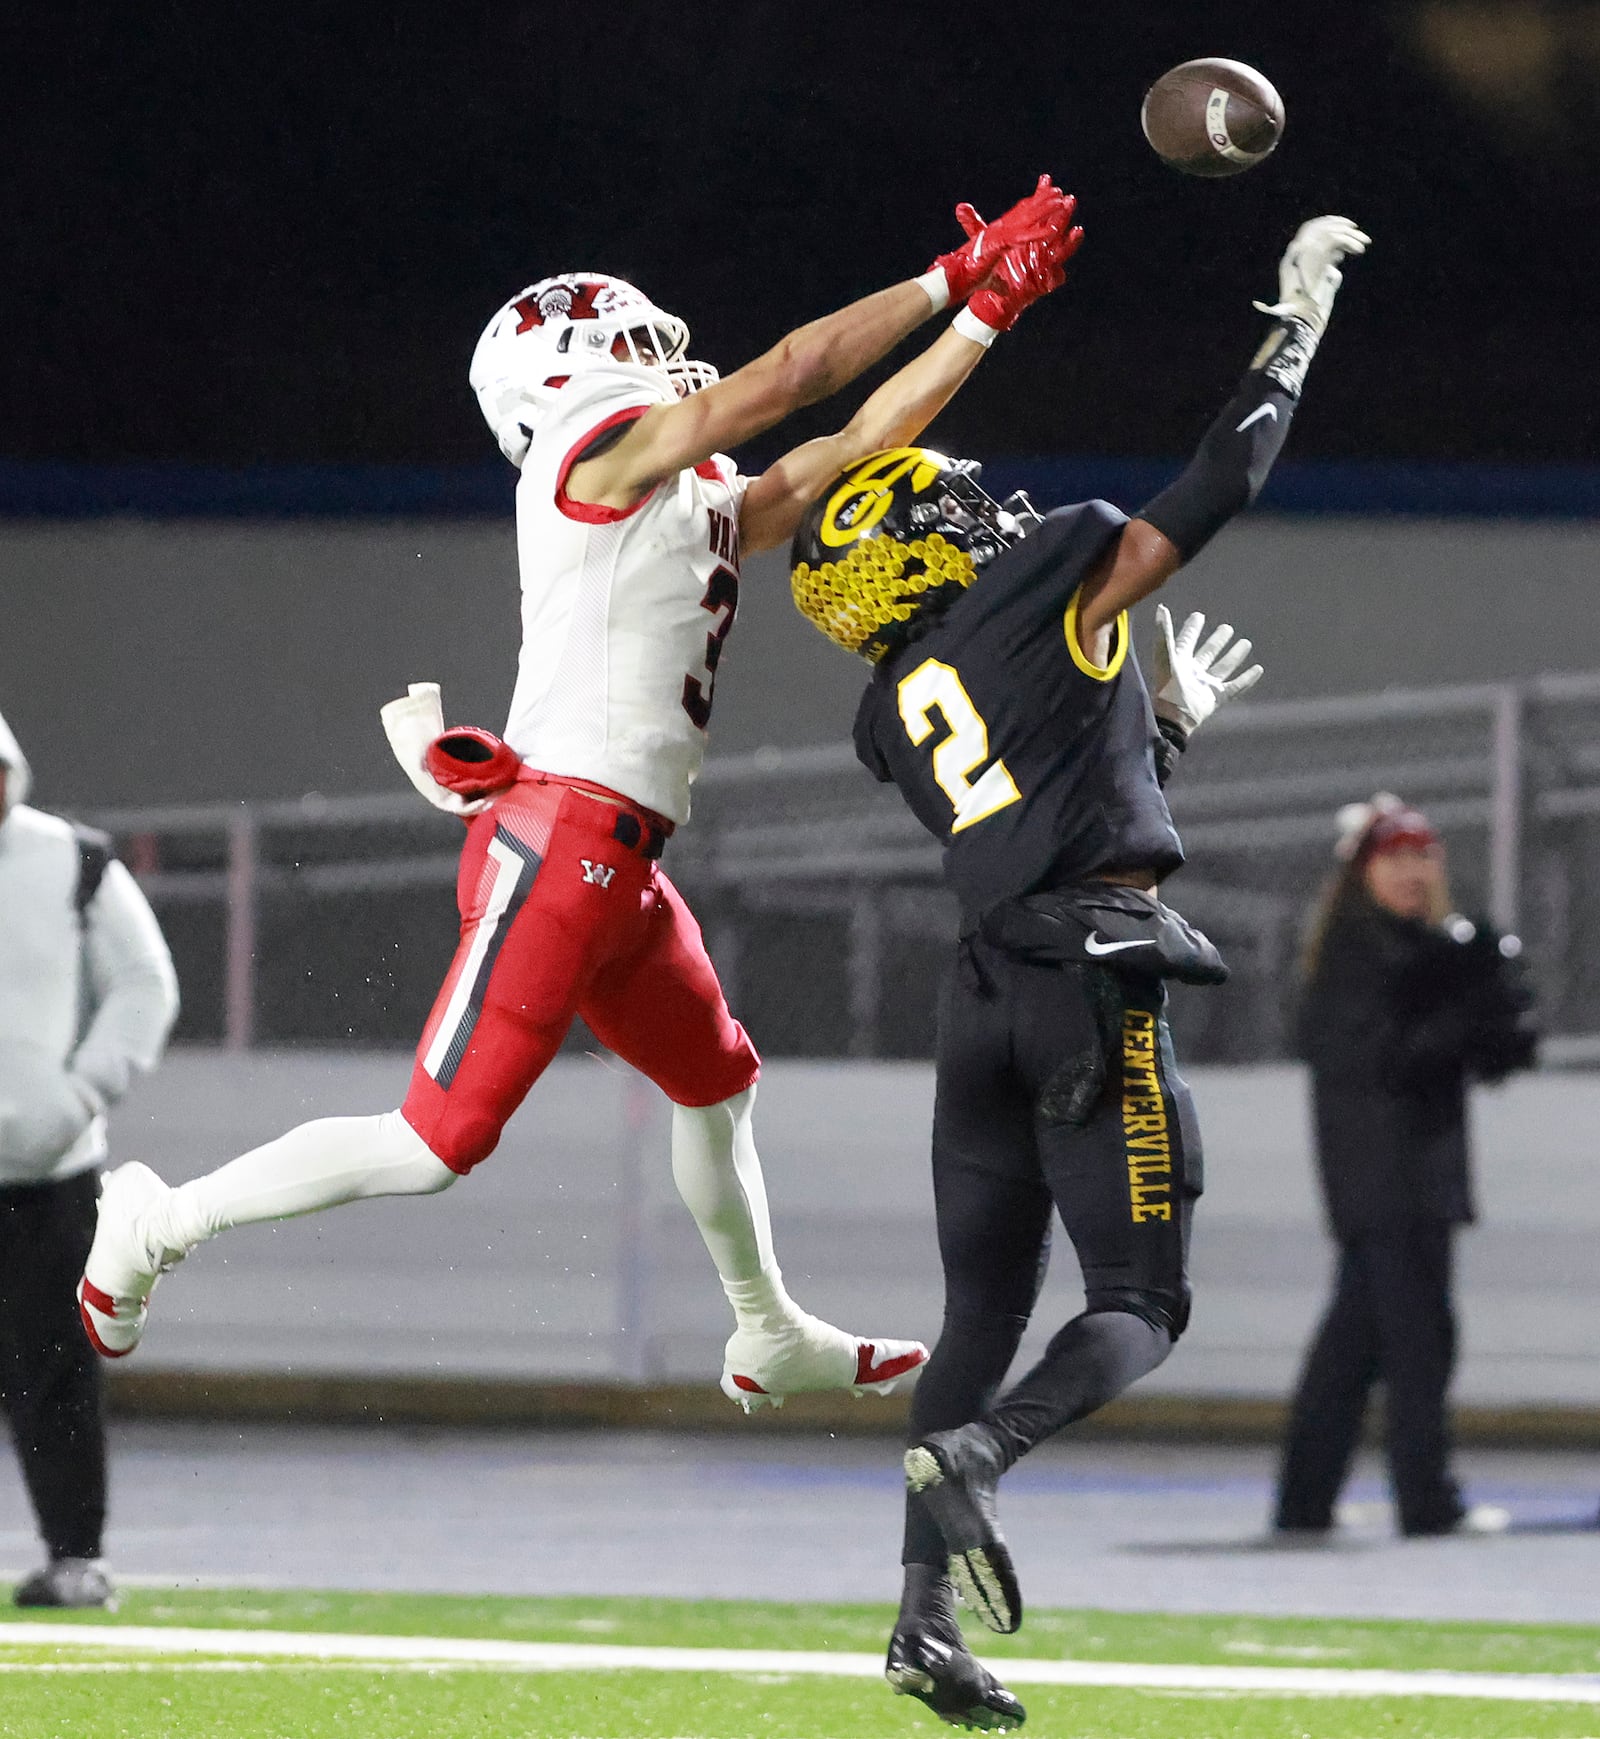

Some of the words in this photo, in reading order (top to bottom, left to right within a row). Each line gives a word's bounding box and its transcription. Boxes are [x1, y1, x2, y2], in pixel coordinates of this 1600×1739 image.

[681, 564, 738, 730] 3
[897, 657, 1023, 834] 2
[1121, 1008, 1173, 1223] CENTERVILLE
